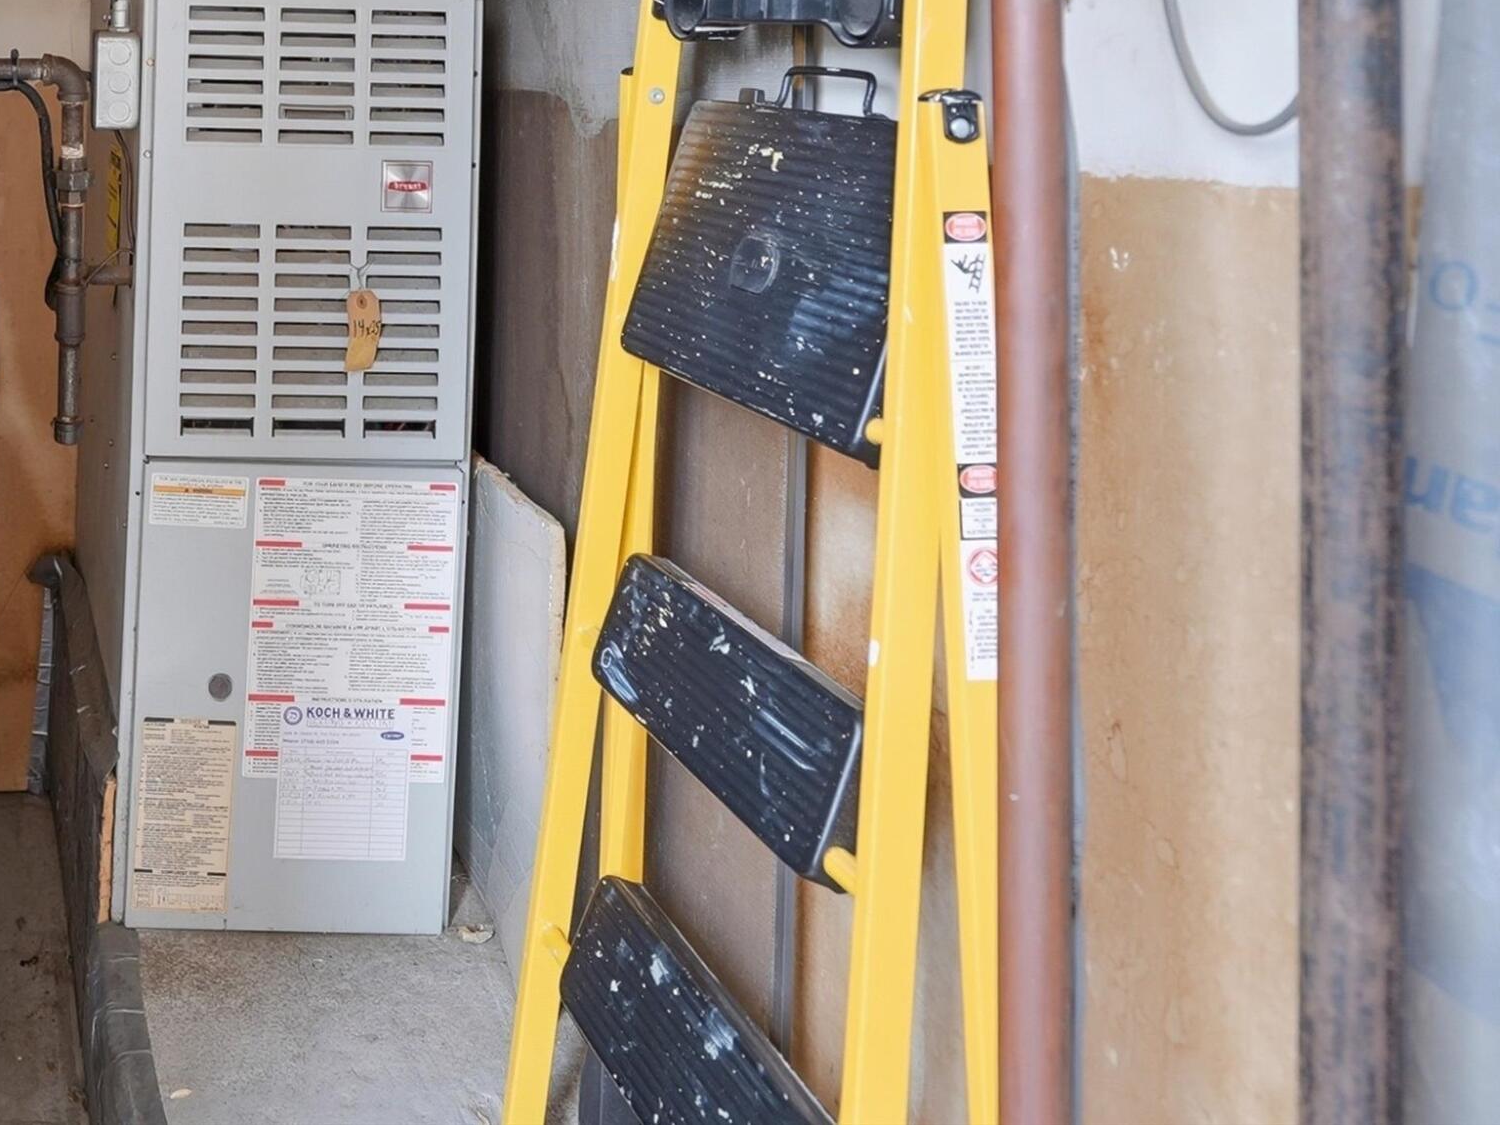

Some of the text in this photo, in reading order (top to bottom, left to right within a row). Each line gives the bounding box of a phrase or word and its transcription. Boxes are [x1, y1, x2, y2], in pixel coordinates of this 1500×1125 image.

[393, 182, 422, 191] bryant
[306, 707, 395, 720] KOCH & WHITE
